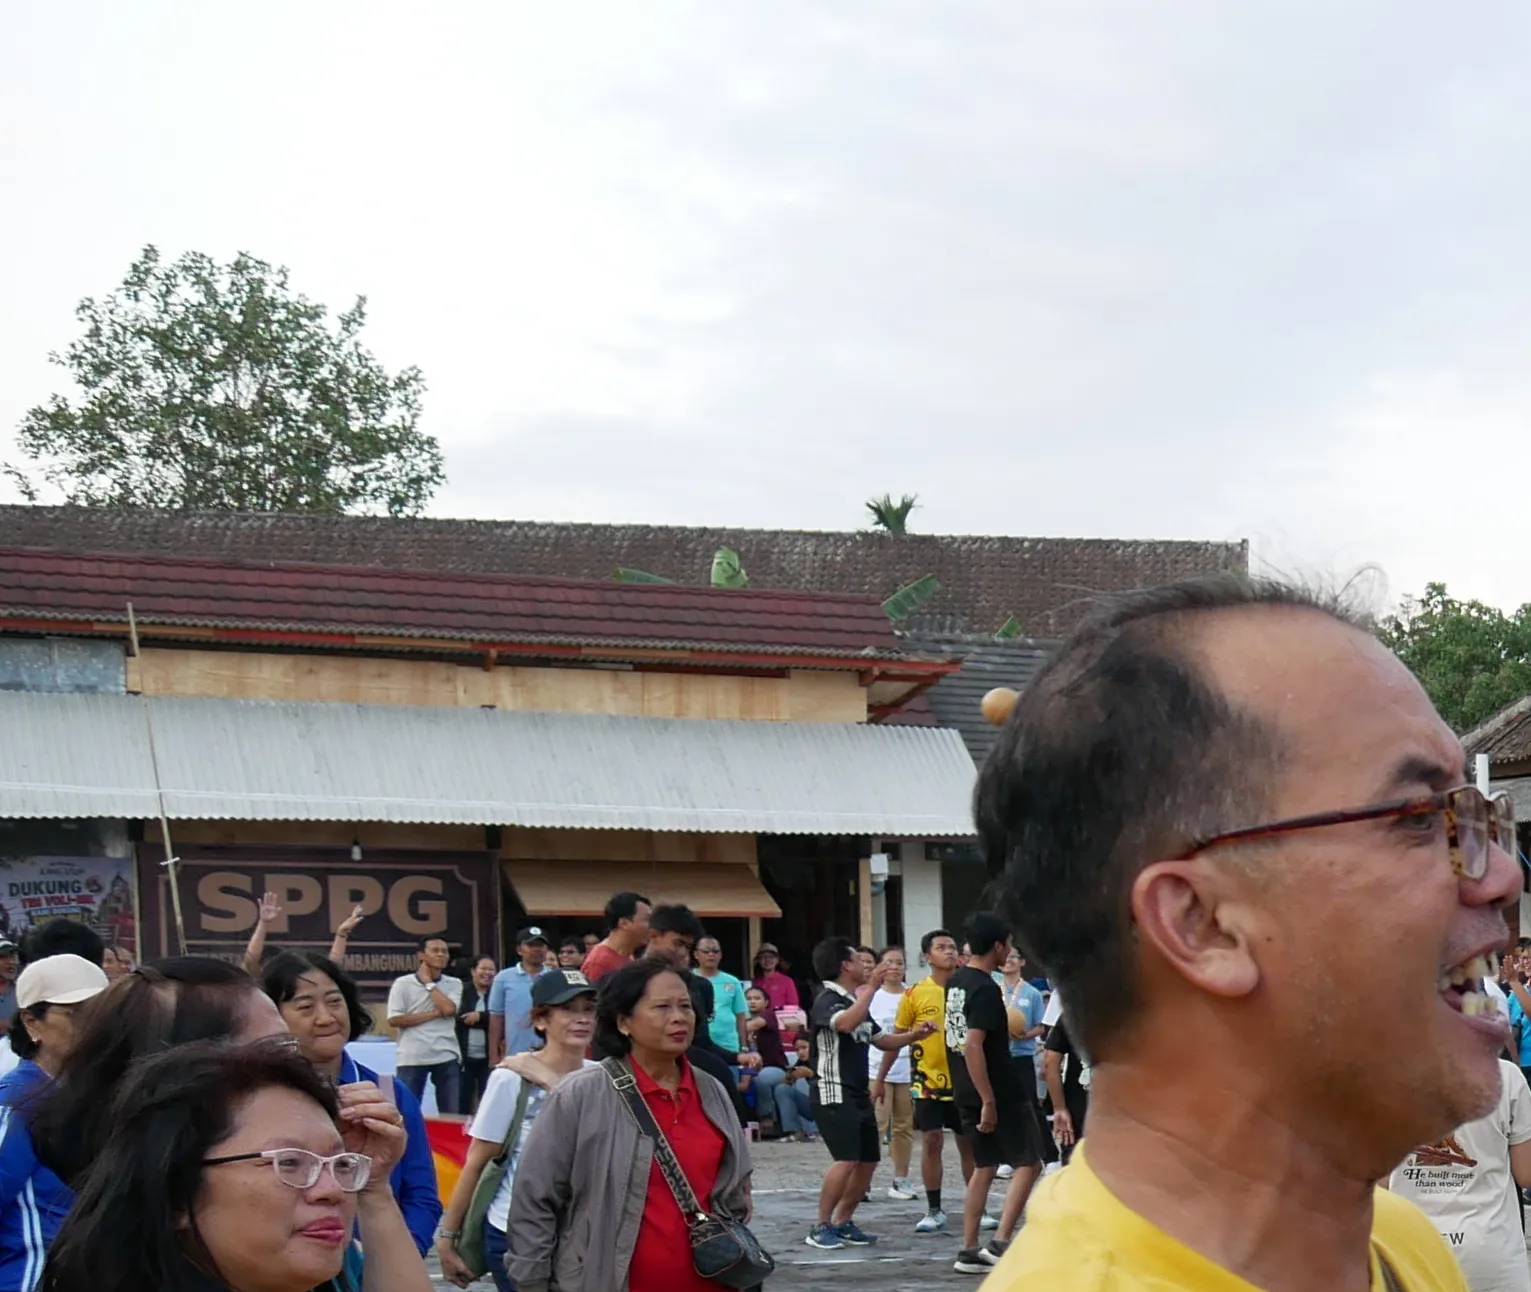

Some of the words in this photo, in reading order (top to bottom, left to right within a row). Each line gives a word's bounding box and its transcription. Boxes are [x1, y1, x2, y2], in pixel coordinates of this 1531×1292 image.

[8, 880, 83, 897] DUKUNG
[197, 871, 448, 935] SPPG
[1403, 1168, 1426, 1180] He
[1428, 1171, 1450, 1180] built
[1415, 1180, 1437, 1188] than
[1439, 1180, 1465, 1188] wood
